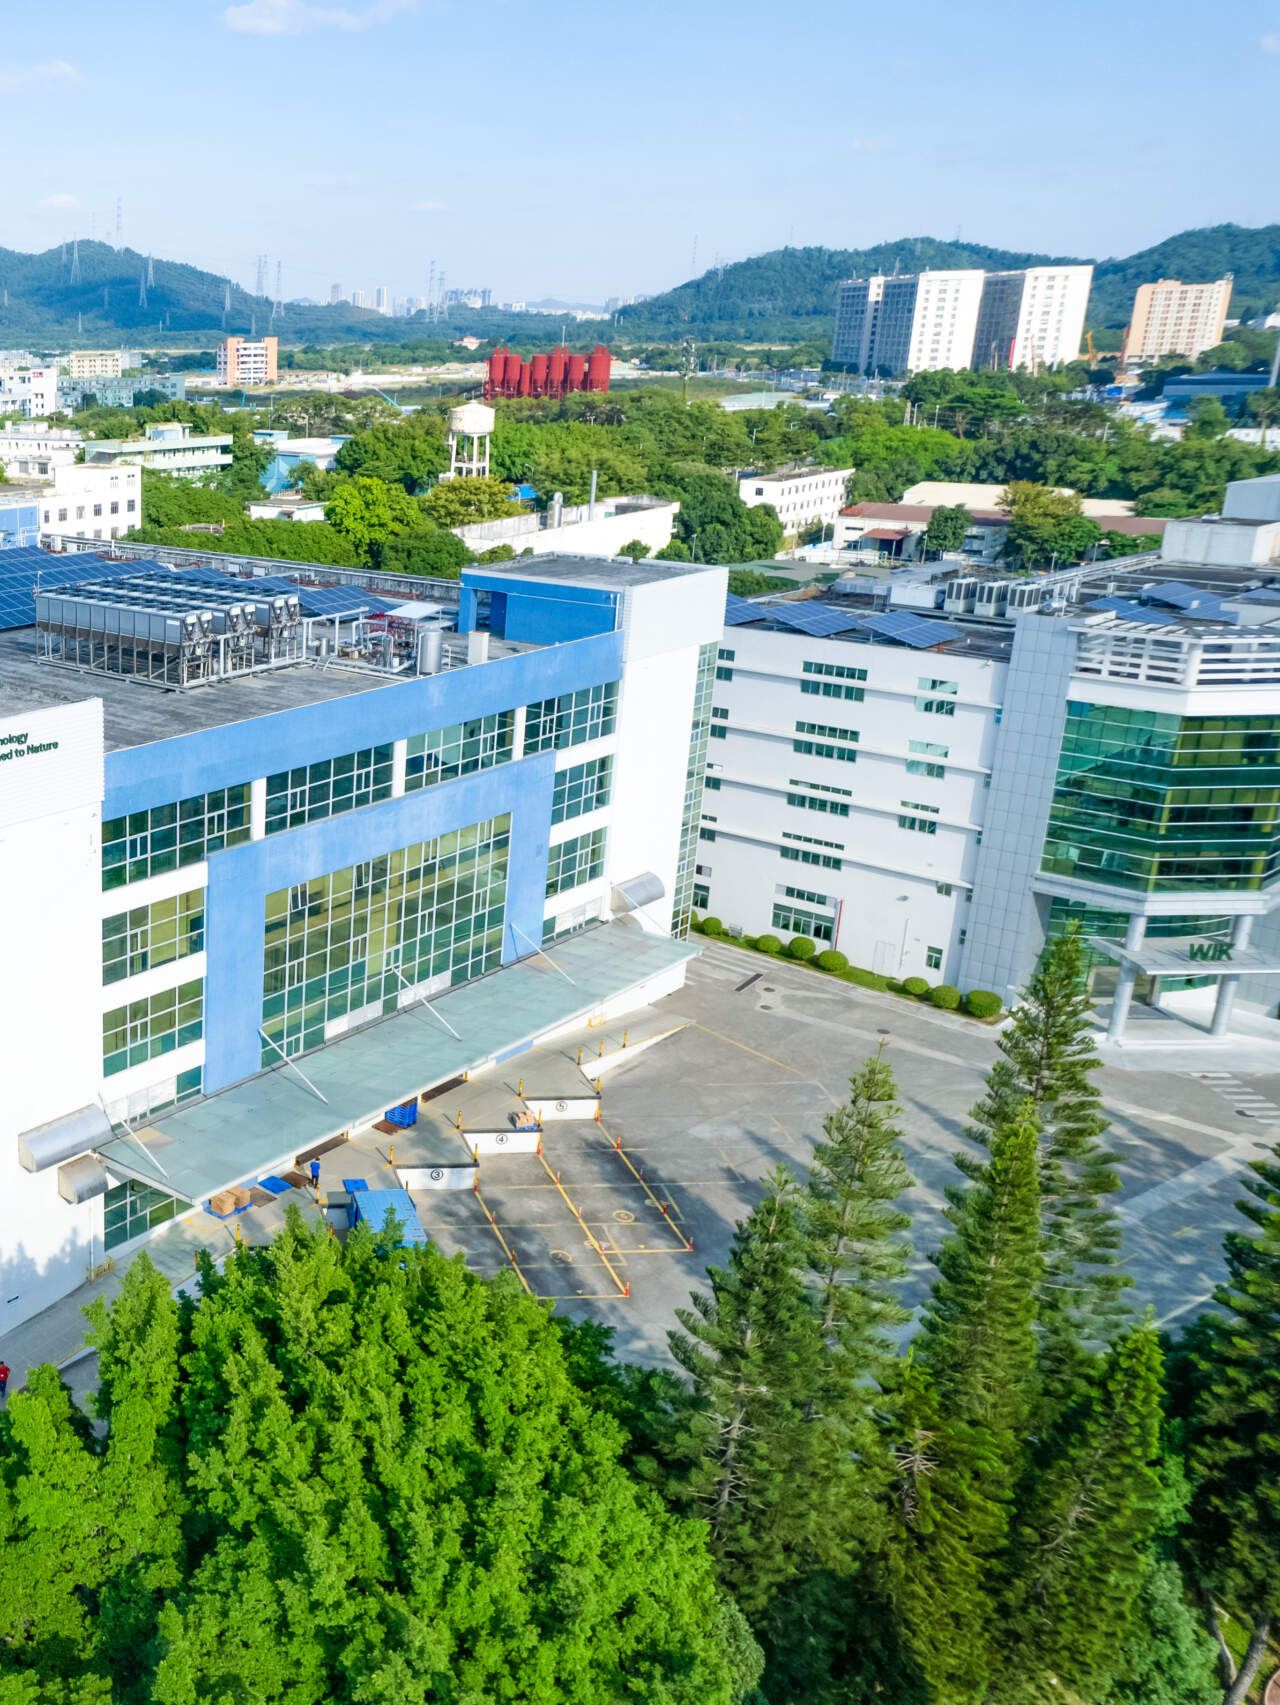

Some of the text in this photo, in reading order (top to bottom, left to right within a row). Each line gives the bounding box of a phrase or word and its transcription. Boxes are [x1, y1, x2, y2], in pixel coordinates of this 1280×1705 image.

[14, 748, 25, 758] to
[26, 741, 59, 755] Nature
[1189, 943, 1234, 961] WIK
